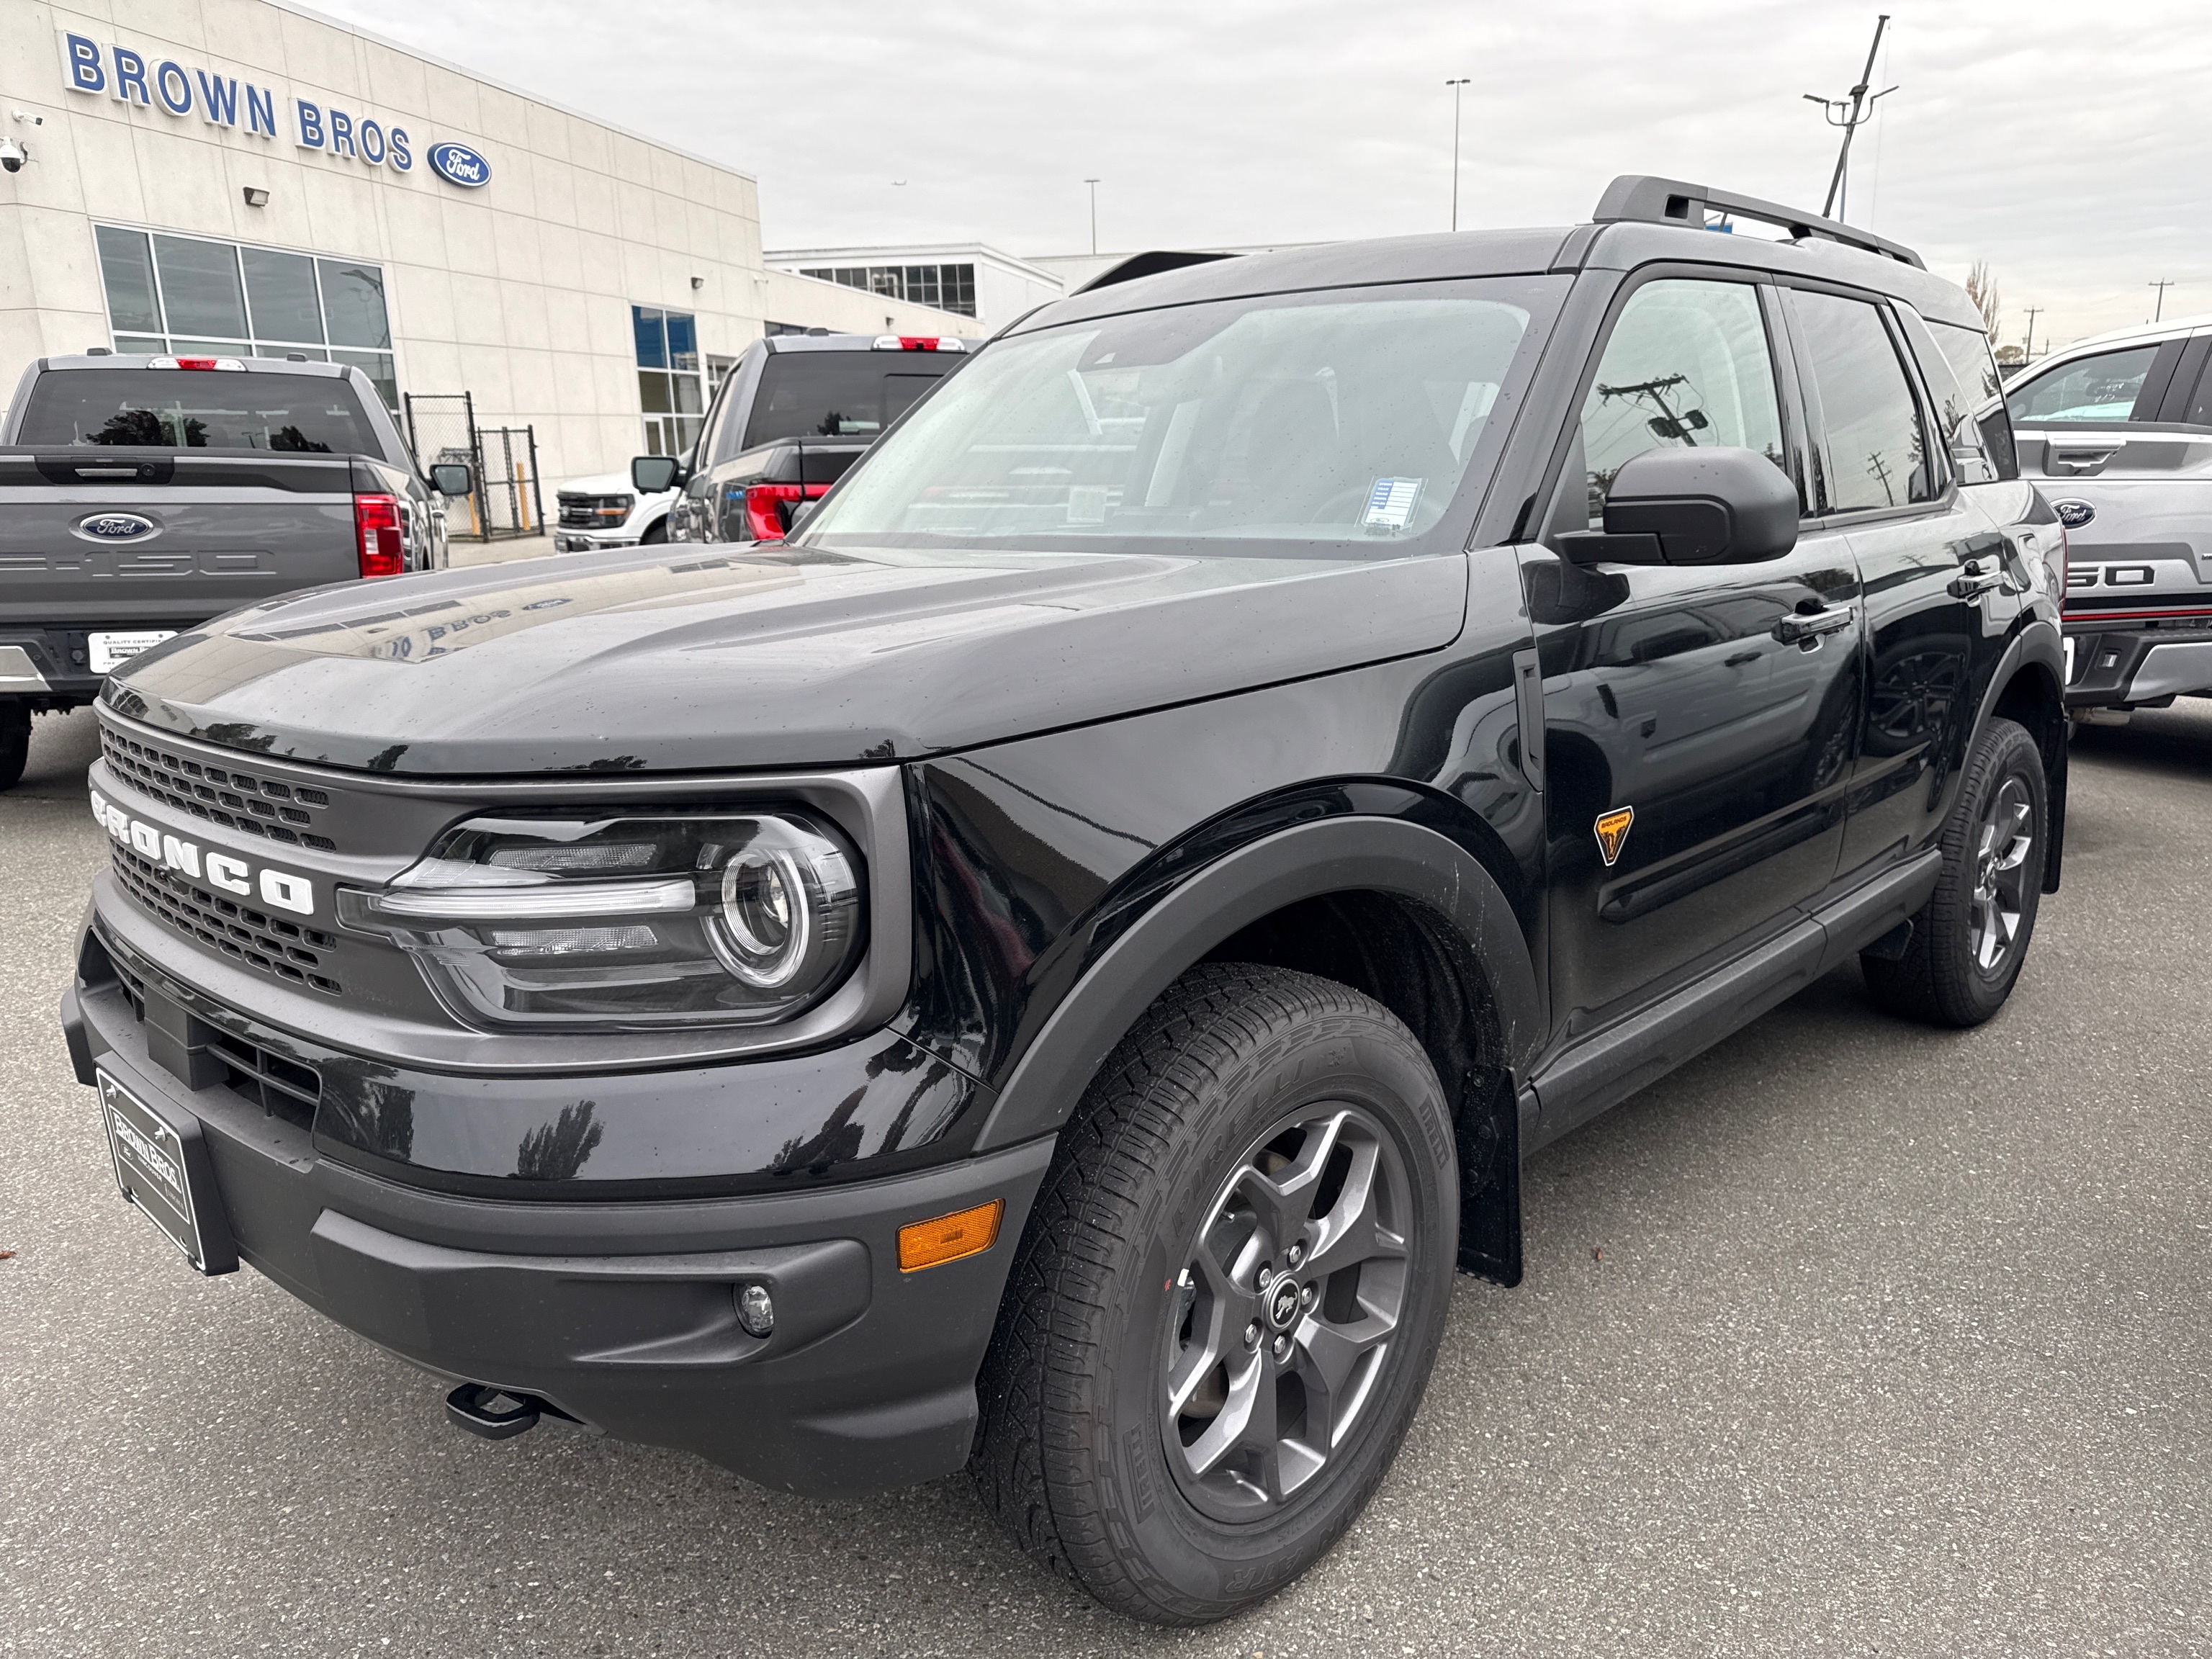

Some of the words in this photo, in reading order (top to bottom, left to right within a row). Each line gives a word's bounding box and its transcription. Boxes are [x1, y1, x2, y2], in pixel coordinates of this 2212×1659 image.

[60, 30, 276, 138] BROWN
[293, 98, 413, 172] BROS
[446, 148, 481, 181] Ford
[96, 518, 135, 534] Ford
[2058, 503, 2087, 522] Ford
[1601, 816, 1627, 829] BADLANDS
[91, 789, 314, 915] BRONCO
[113, 1112, 150, 1162] BROWN
[1418, 1093, 1450, 1171] PIRELLI
